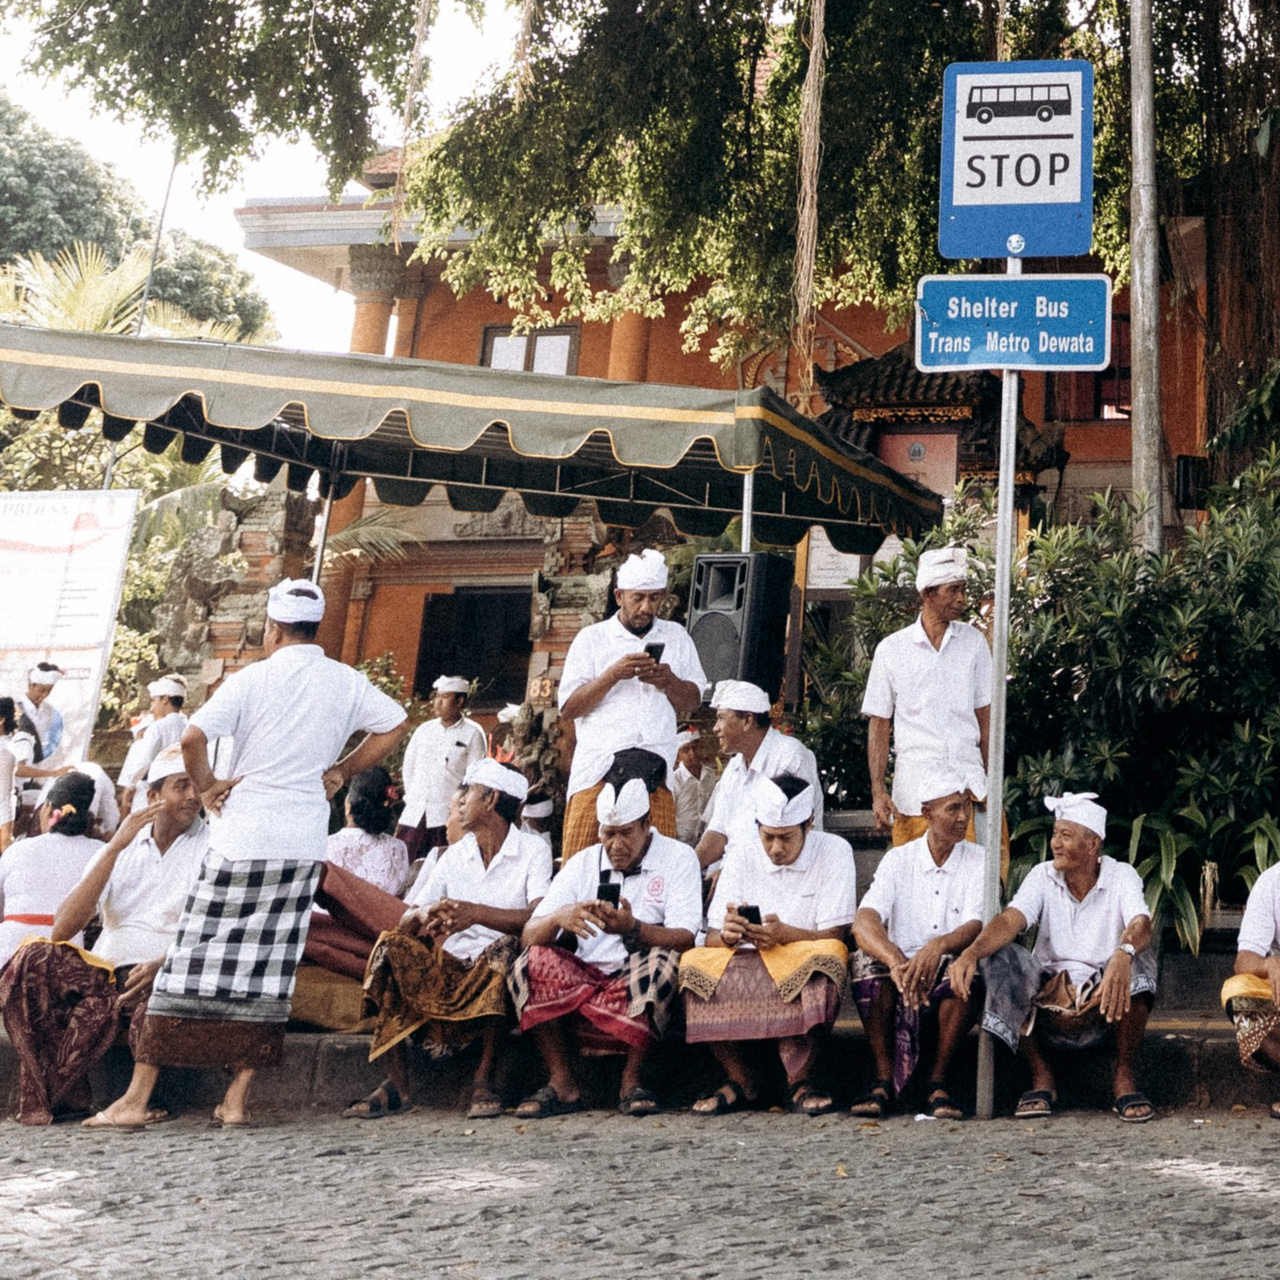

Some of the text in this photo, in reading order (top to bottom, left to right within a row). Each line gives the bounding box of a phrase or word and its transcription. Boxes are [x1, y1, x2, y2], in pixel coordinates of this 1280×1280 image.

[965, 153, 1070, 188] STOP
[947, 296, 1069, 319] Shelter Bus
[928, 331, 1095, 354] Trans Metro Dewata
[529, 679, 551, 698] 83
